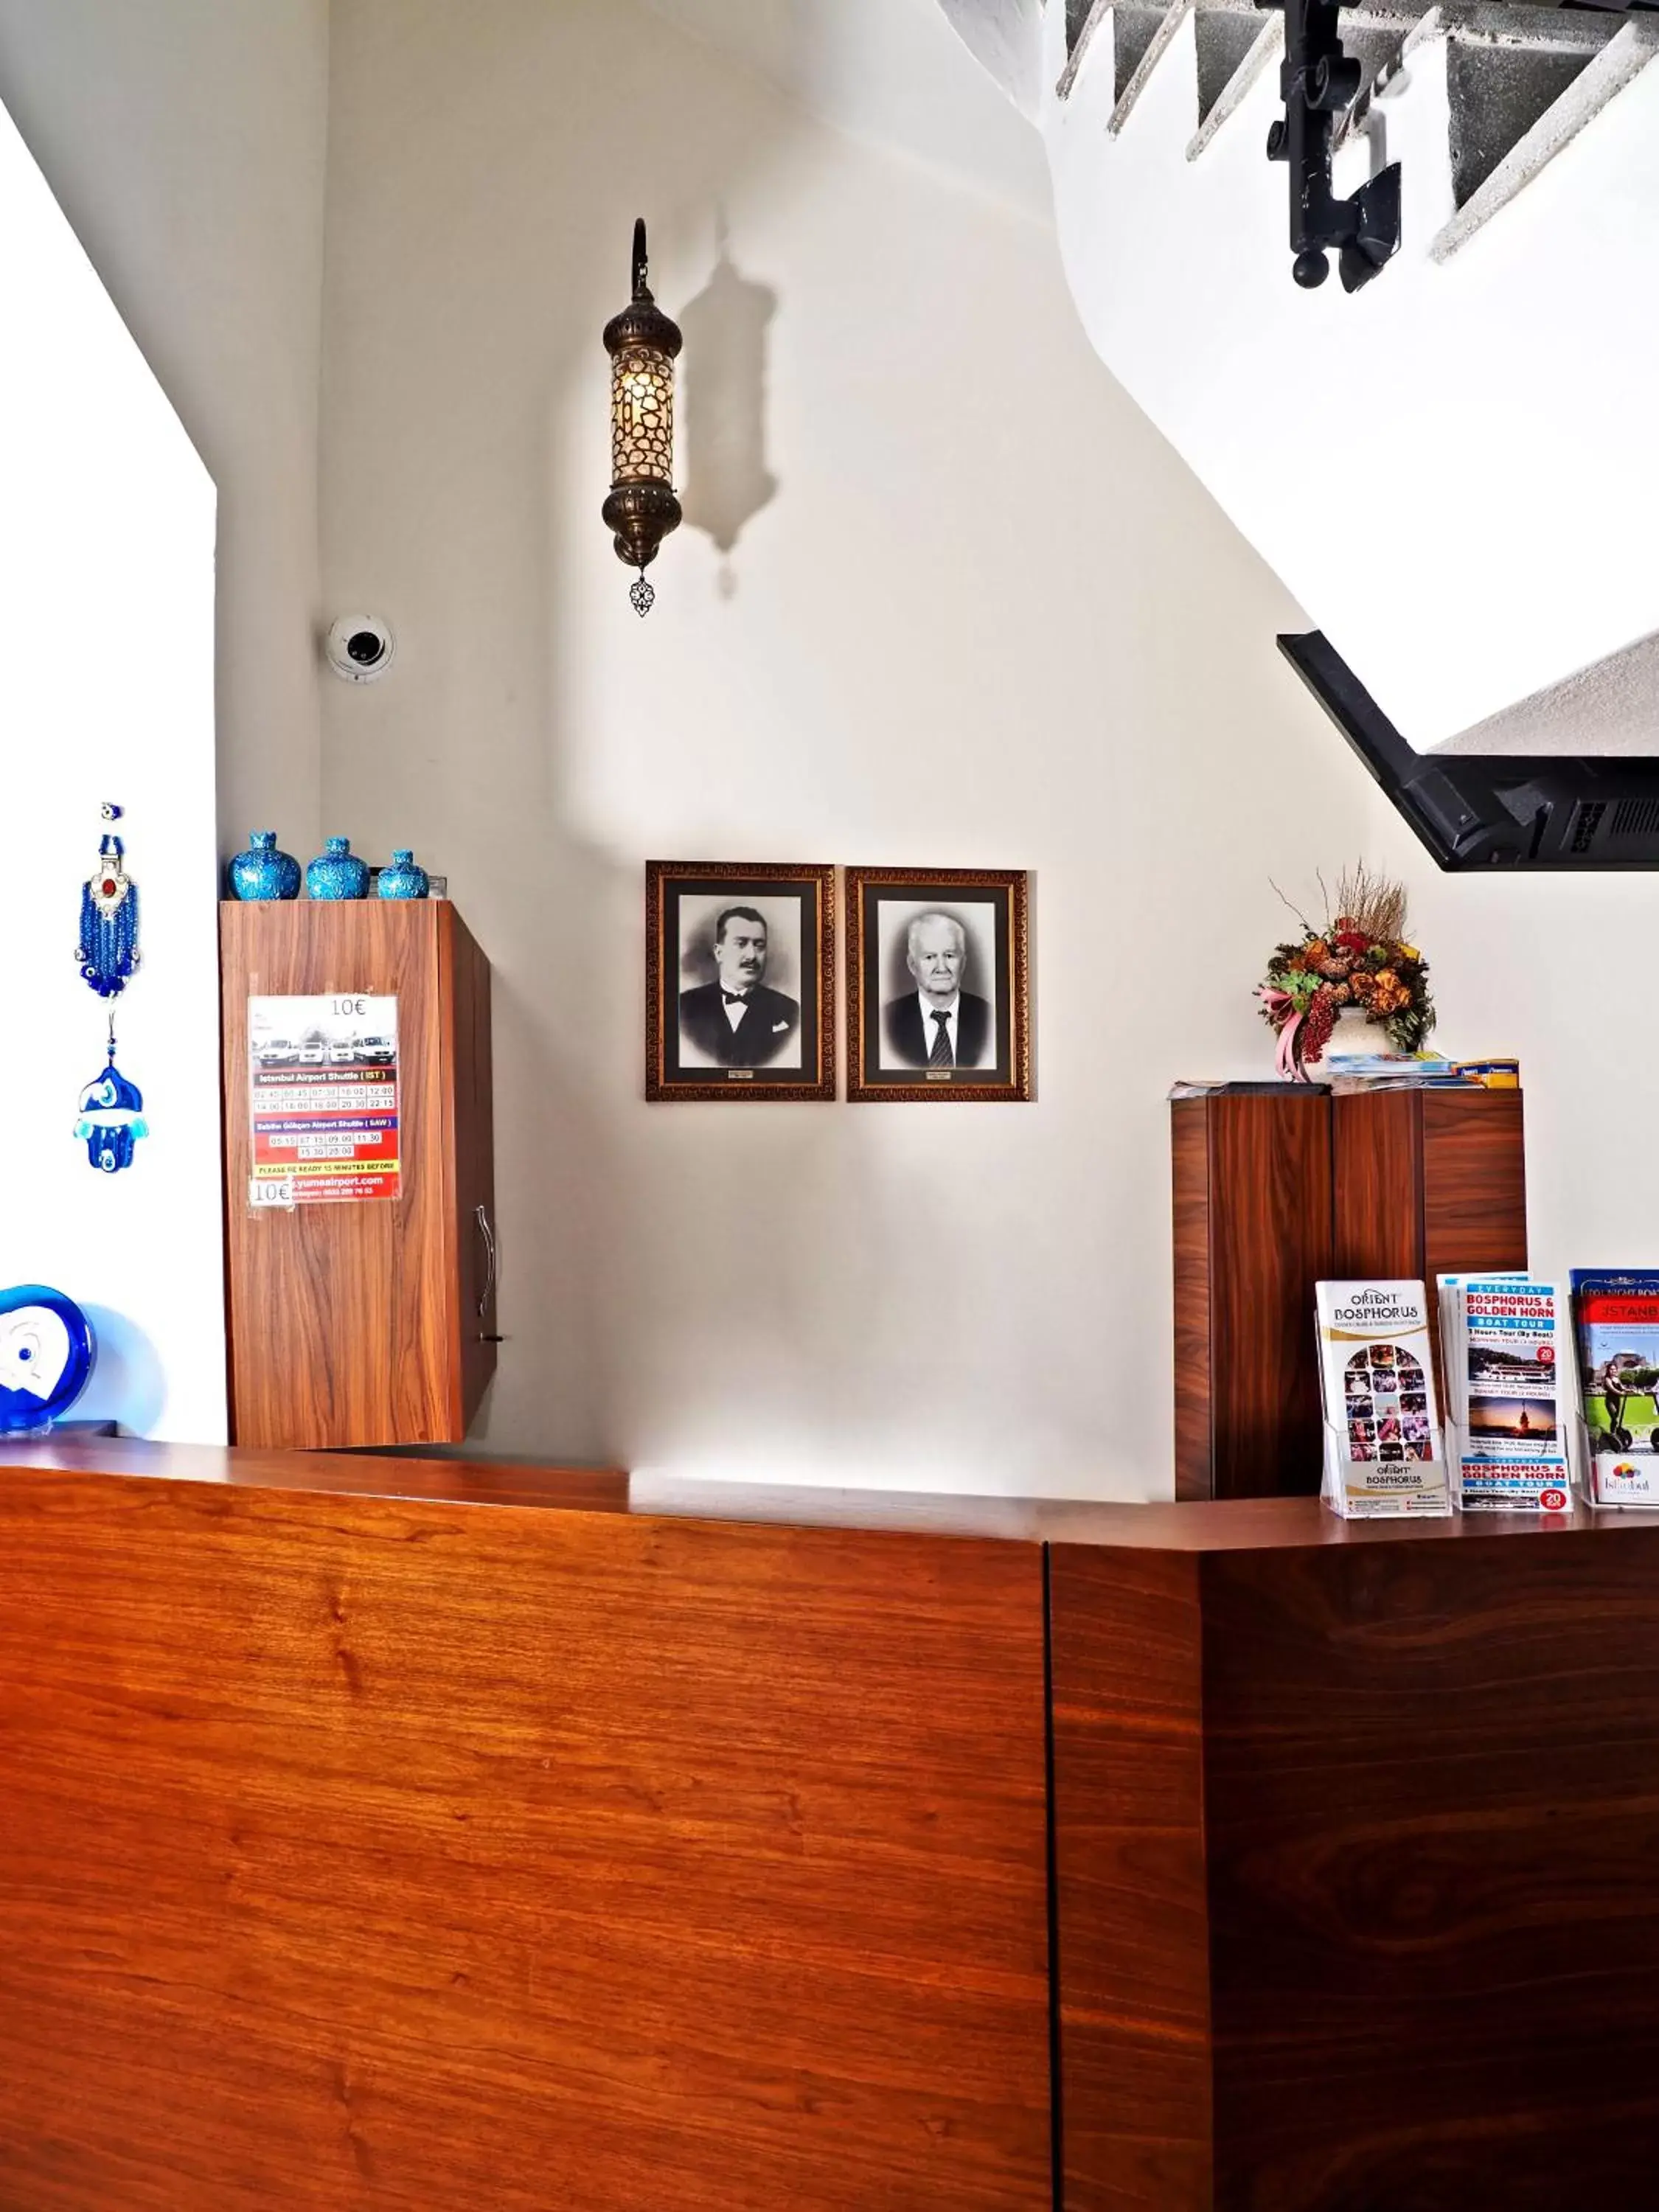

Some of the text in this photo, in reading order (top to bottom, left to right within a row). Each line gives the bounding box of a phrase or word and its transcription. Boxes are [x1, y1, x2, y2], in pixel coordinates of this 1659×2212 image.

[332, 998, 366, 1015] 10€
[296, 1073, 326, 1083] Airport
[328, 1071, 358, 1081] Shuttle
[299, 1164, 321, 1172] READY
[366, 1162, 394, 1170] BEFORE
[255, 1183, 290, 1200] 10€
[1478, 1285, 1543, 1294] EVERYDAY
[1351, 1289, 1397, 1305] ORIENT
[1467, 1294, 1554, 1307] BOSPHORUS &
[1335, 1307, 1418, 1321] BOSPHORUS
[1467, 1305, 1554, 1318] GOLDEN HORN
[1478, 1317, 1545, 1328] BOAT TOUR
[1366, 1475, 1422, 1485] BOSPHORUS
[1545, 1493, 1561, 1503] 20
